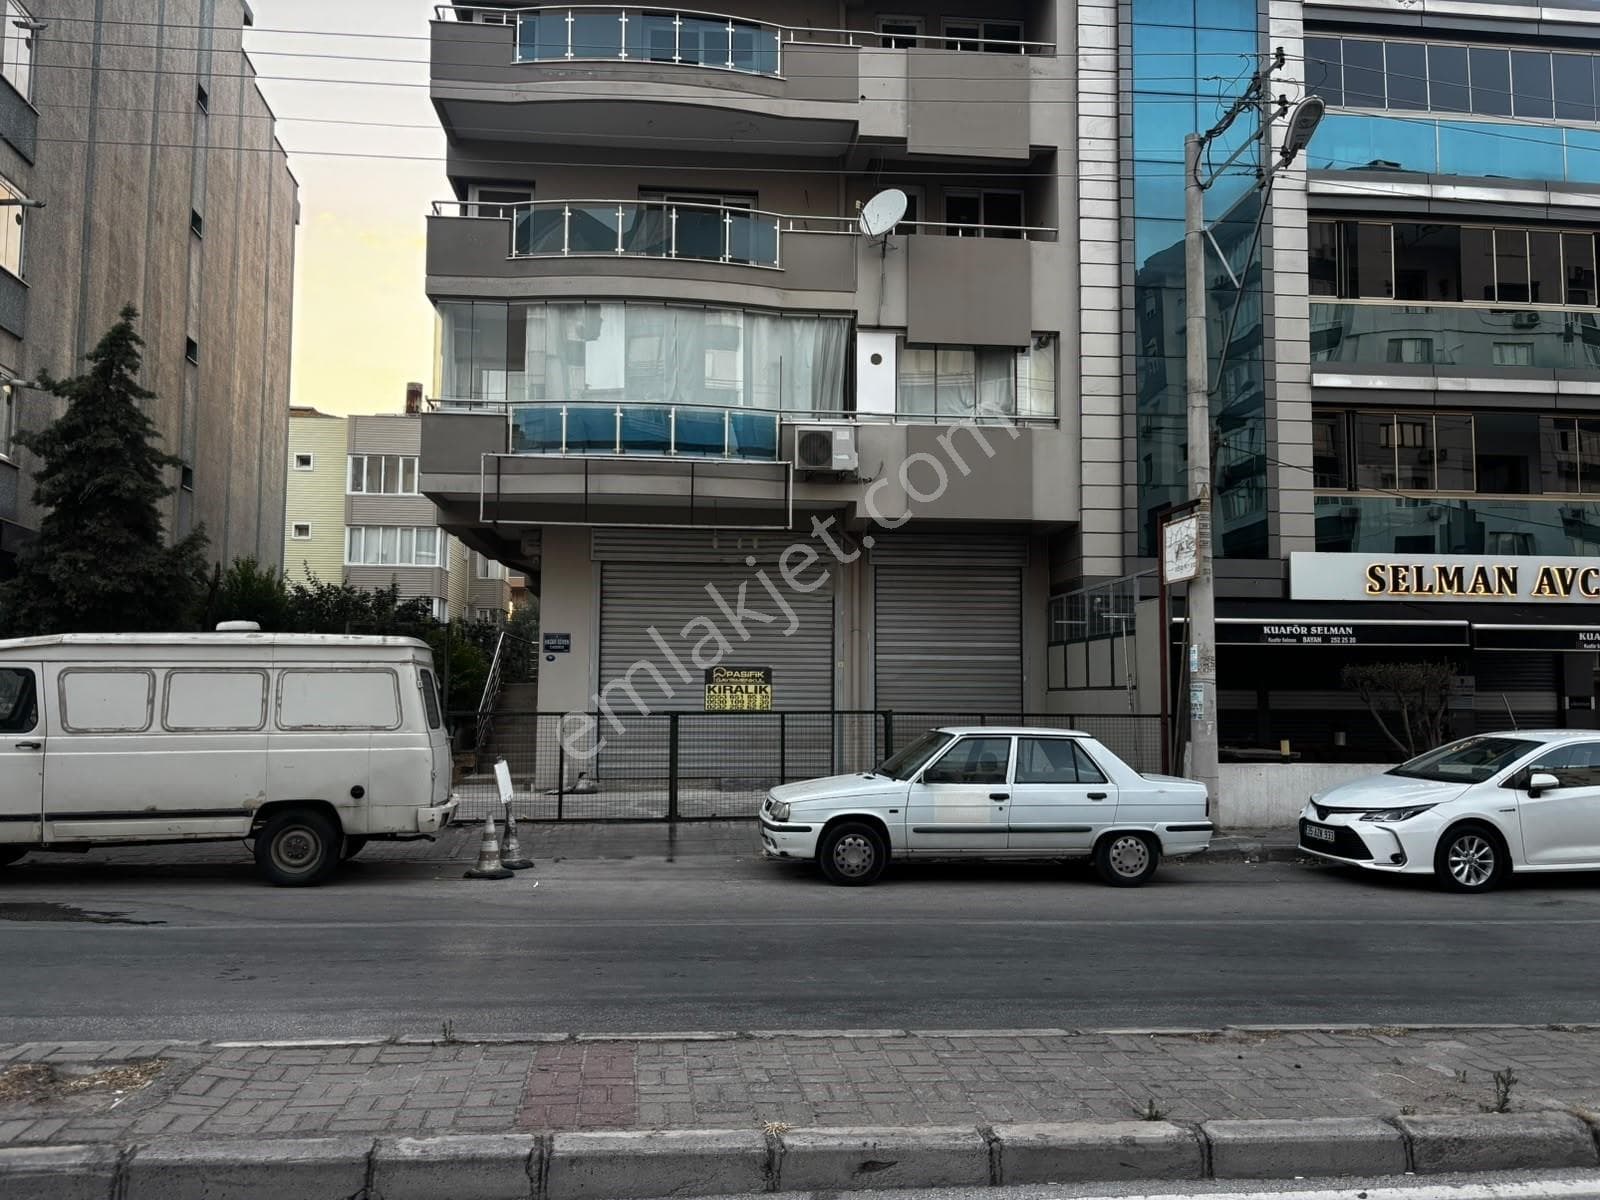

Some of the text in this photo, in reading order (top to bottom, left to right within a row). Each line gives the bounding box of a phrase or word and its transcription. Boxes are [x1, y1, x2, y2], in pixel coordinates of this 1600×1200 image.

[1366, 563, 1600, 598] SELMAN AVC
[1311, 626, 1353, 635] SELMAN
